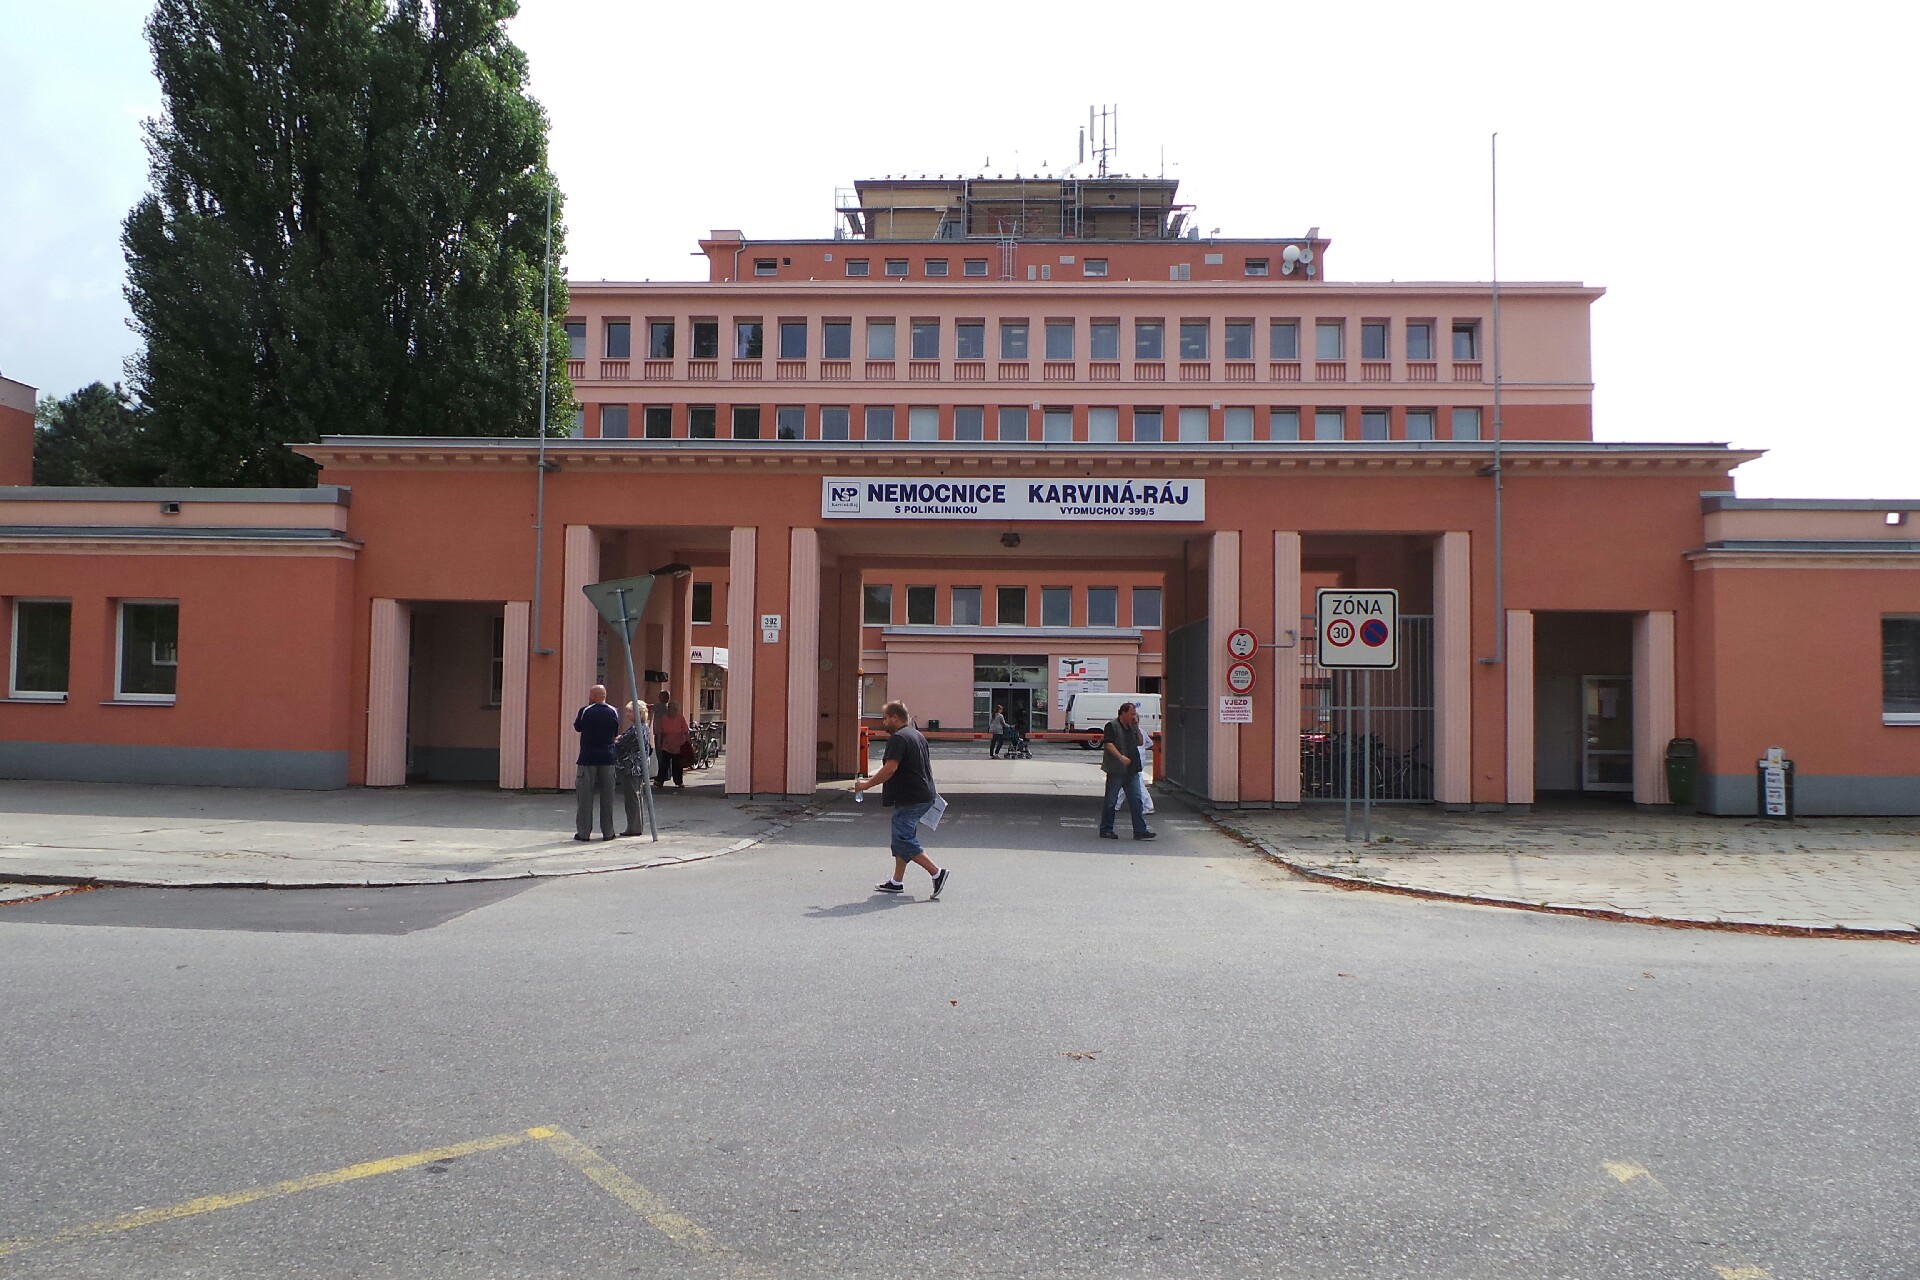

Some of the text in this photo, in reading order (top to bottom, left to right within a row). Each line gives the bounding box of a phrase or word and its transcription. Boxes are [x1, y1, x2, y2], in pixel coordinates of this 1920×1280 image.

[867, 480, 1189, 505] NEMOCNICE KARVINÁ-RÁJ
[894, 506, 978, 514] S POLIKLINIKOU
[1060, 507, 1155, 516] VYDMUCHOV 399/5
[1332, 595, 1383, 615] ZÓNA
[764, 617, 778, 625] 392
[1333, 627, 1349, 639] 30
